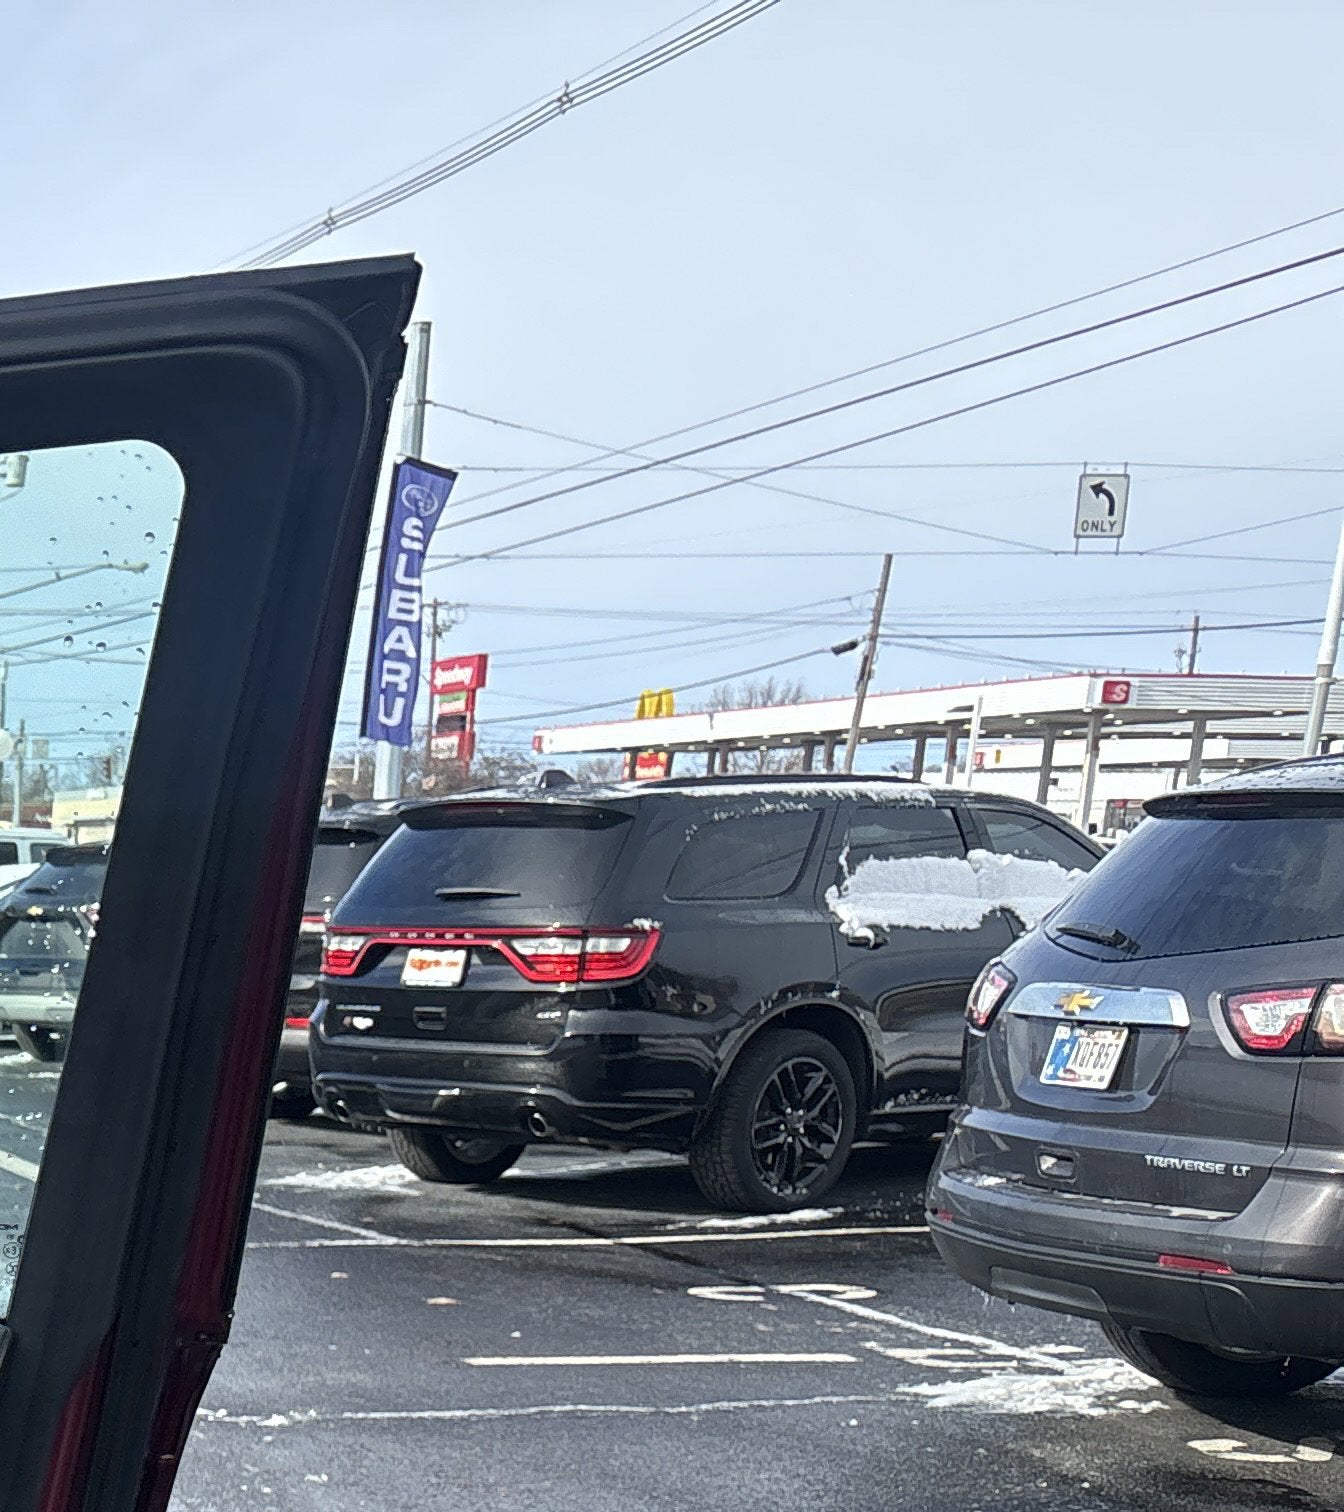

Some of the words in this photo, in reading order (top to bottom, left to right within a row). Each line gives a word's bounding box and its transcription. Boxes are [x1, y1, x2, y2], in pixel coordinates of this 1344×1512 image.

[1081, 519, 1117, 532] ONLY
[1144, 1154, 1226, 1175] TRAVERSE
[1233, 1165, 1251, 1177] LT
